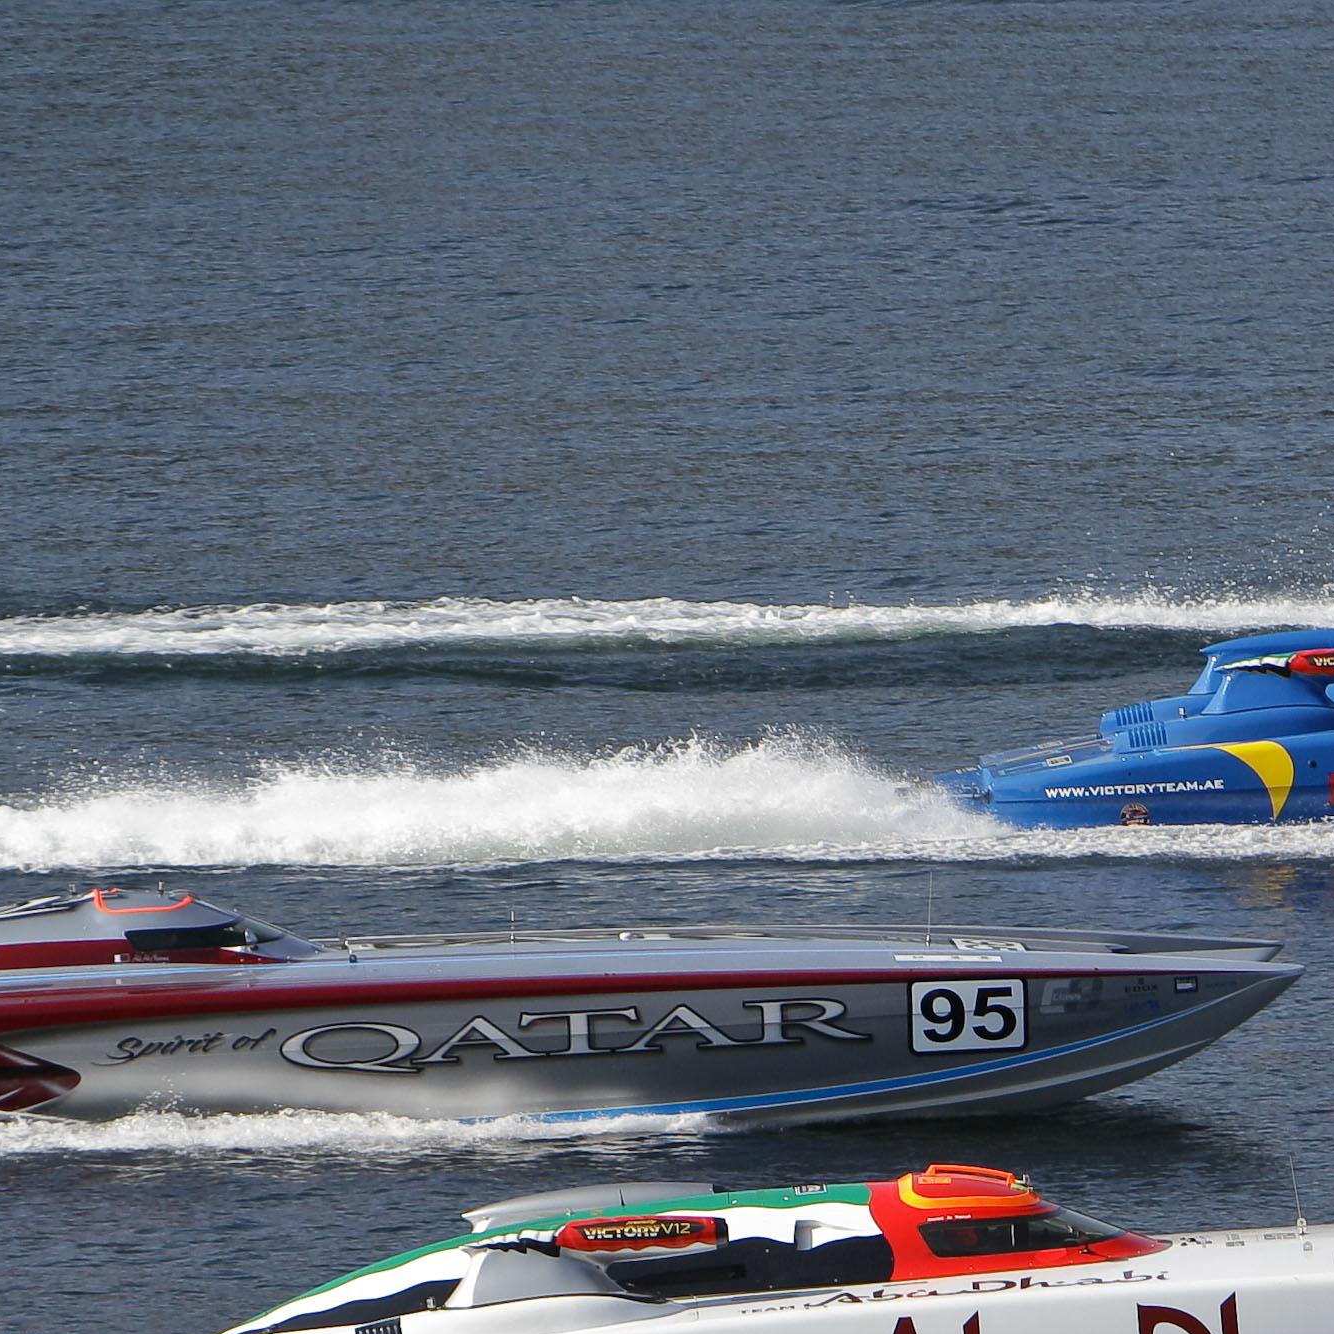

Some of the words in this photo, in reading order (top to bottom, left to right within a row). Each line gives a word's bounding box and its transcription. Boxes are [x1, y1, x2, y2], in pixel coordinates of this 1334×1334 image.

[1045, 779, 1225, 799] WWW.VICTORYTEAM.AE
[919, 986, 1017, 1043] 95
[92, 1023, 230, 1065] Spirit
[231, 1027, 278, 1052] of
[279, 997, 874, 1074] QATAR
[583, 1223, 661, 1241] VICTORY
[661, 1221, 692, 1236] V12
